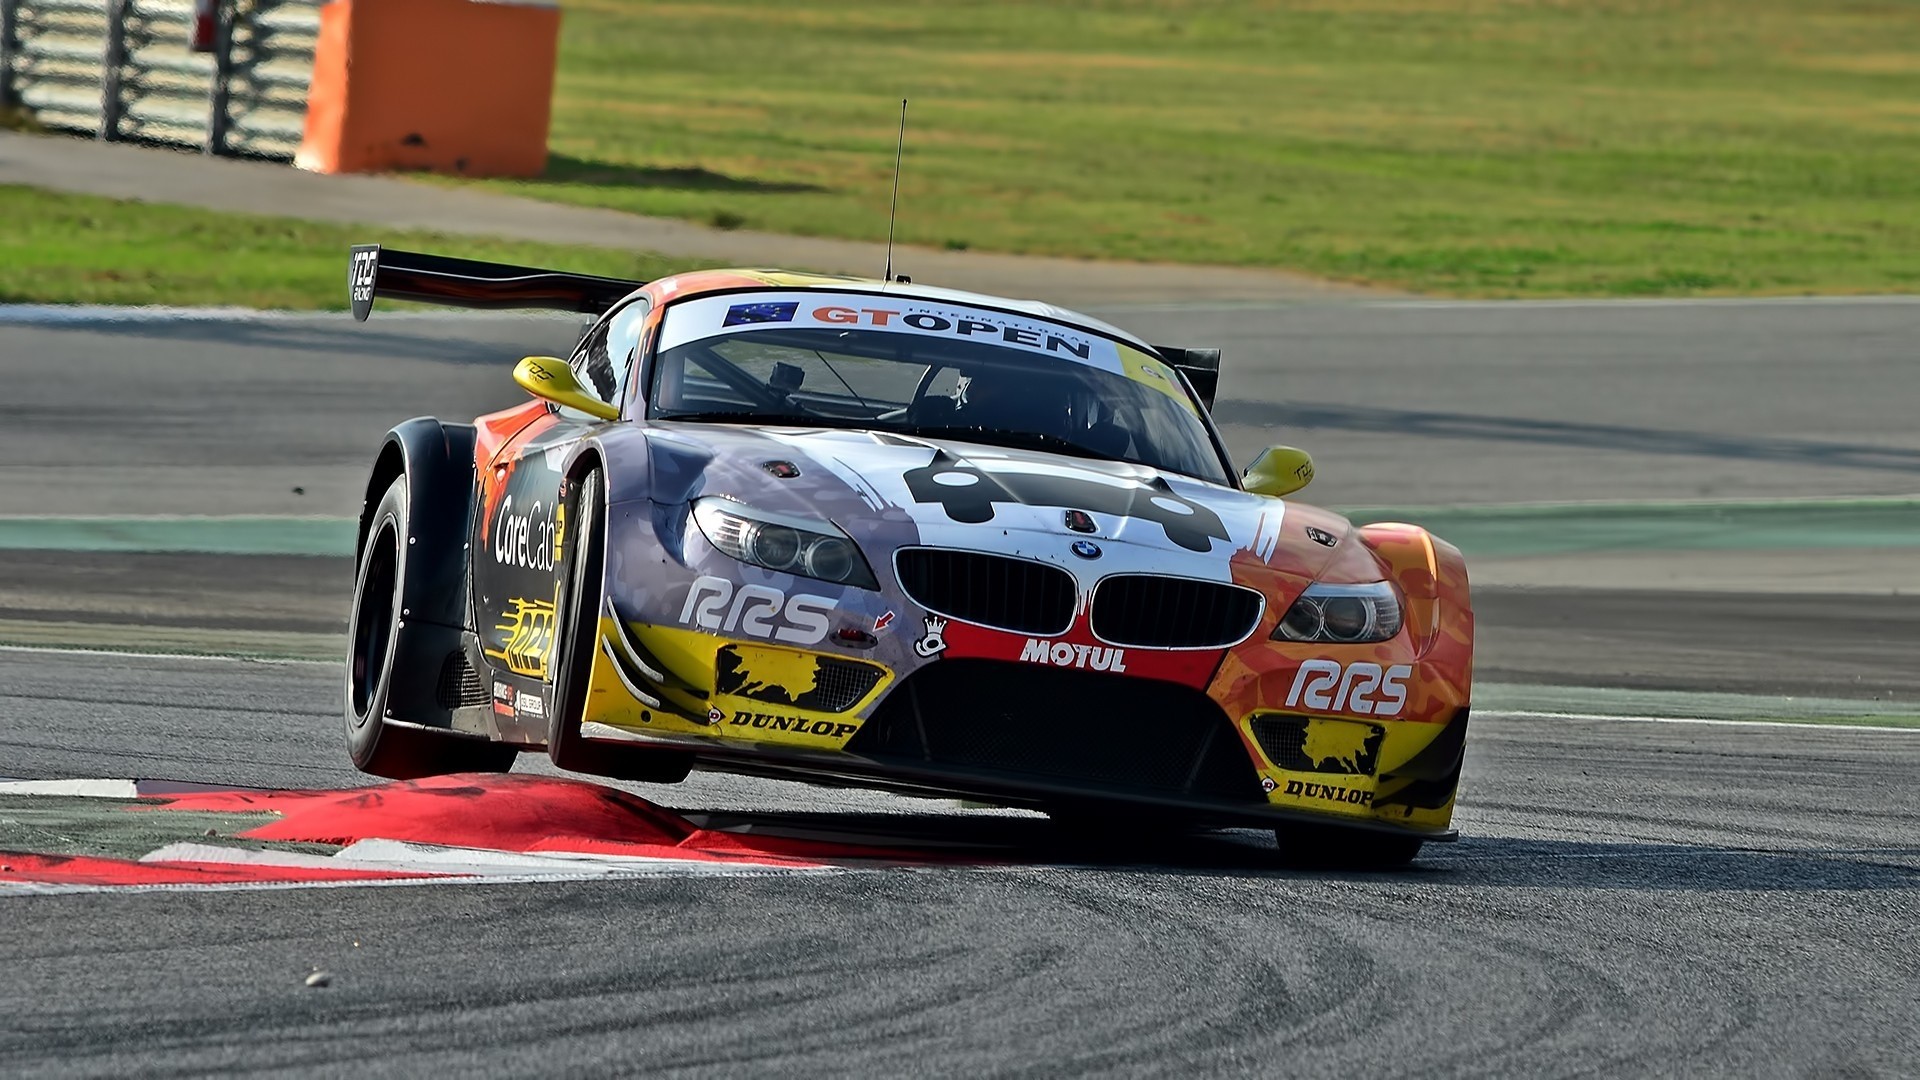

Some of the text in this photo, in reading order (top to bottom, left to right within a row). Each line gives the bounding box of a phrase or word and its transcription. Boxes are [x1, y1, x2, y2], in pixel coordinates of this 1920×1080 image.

[908, 307, 1092, 344] INTERNATIONAL
[495, 495, 555, 571] CoreCab
[679, 575, 839, 645] RRS
[1020, 638, 1126, 673] MOTUL
[1285, 659, 1413, 715] RRS
[730, 711, 858, 738] DUNLOP
[1284, 780, 1375, 805] DUNLOP
